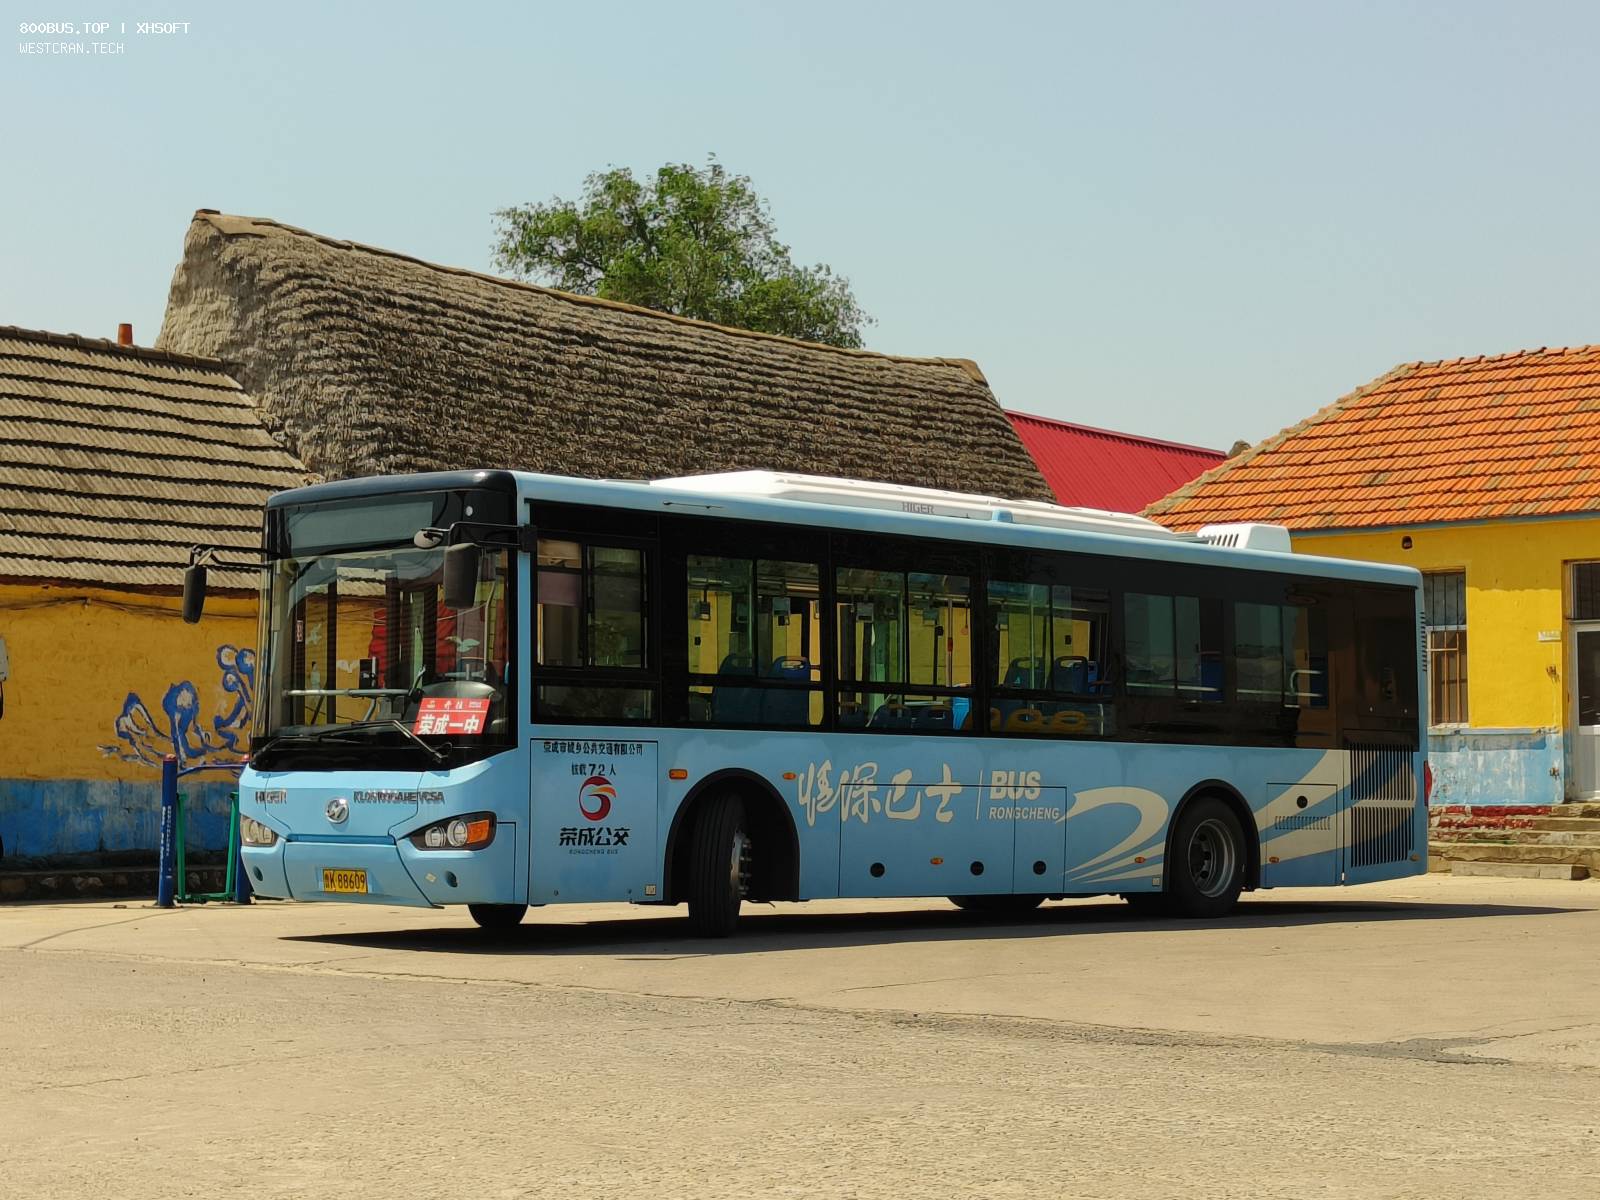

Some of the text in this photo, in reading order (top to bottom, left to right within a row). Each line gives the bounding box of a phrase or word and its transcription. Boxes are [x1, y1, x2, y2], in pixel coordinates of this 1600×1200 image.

[902, 501, 934, 514] HIGER
[417, 714, 480, 735] 荣成一中
[989, 769, 1041, 801] BUS
[988, 806, 1060, 821] RONGCHENG
[559, 827, 630, 846] 荣成公交
